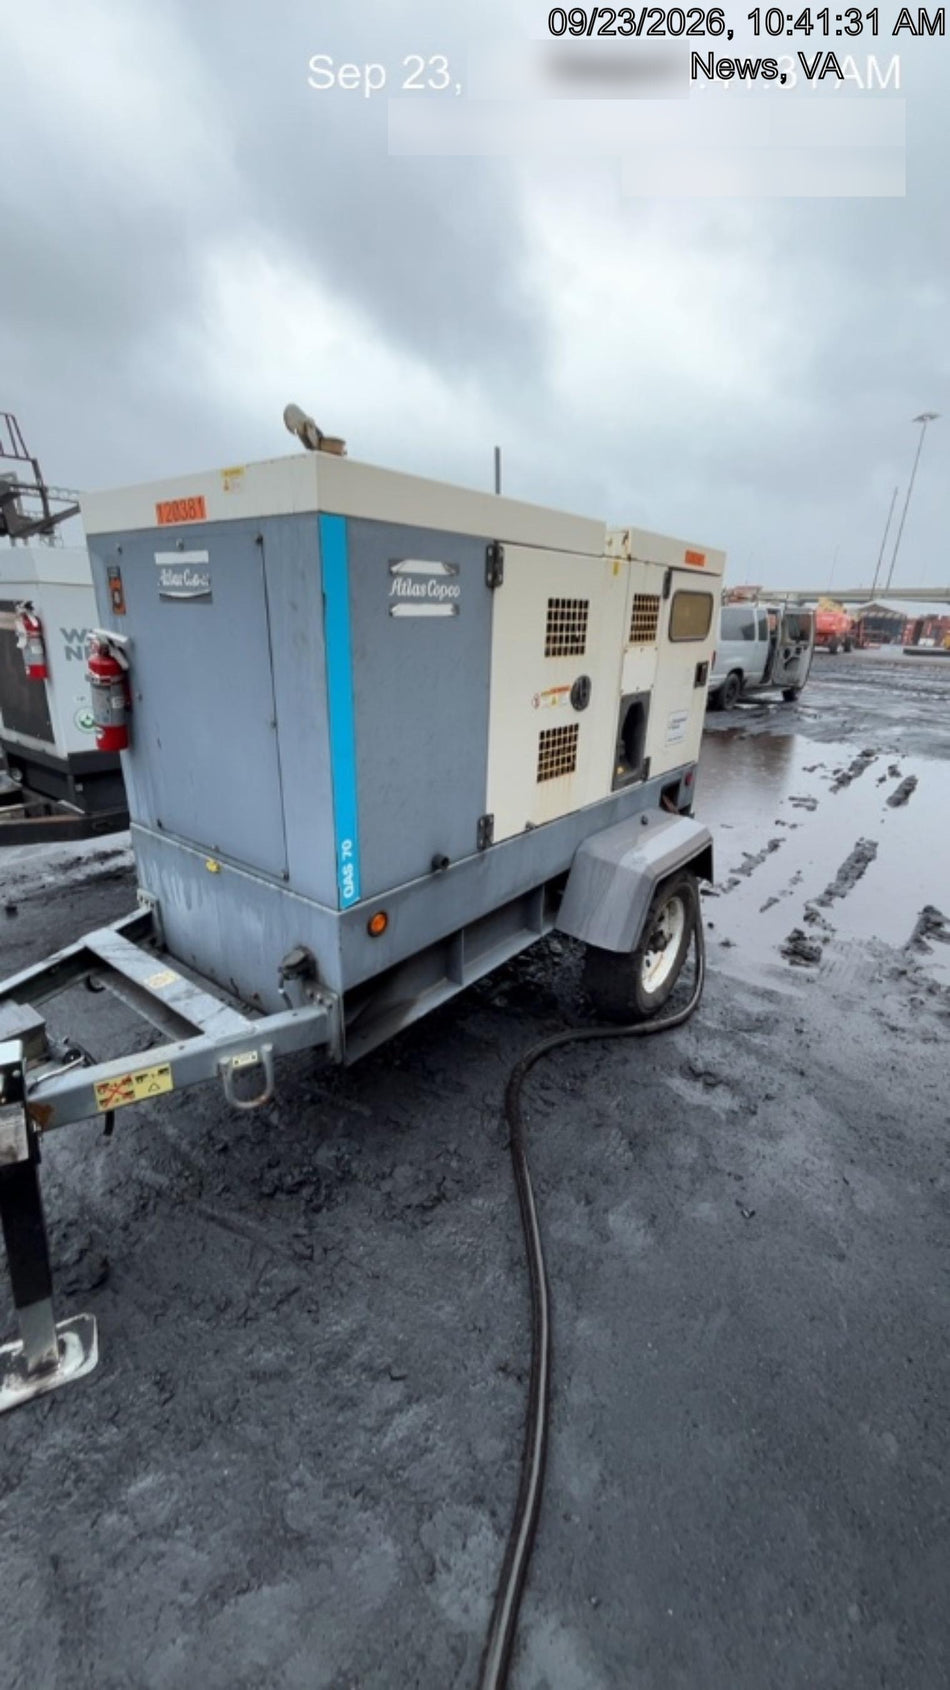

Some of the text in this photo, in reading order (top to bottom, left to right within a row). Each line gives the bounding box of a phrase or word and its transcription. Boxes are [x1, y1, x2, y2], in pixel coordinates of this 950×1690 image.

[155, 495, 207, 526] 120381
[389, 578, 461, 601] Atlas Copco
[341, 839, 353, 861] 70
